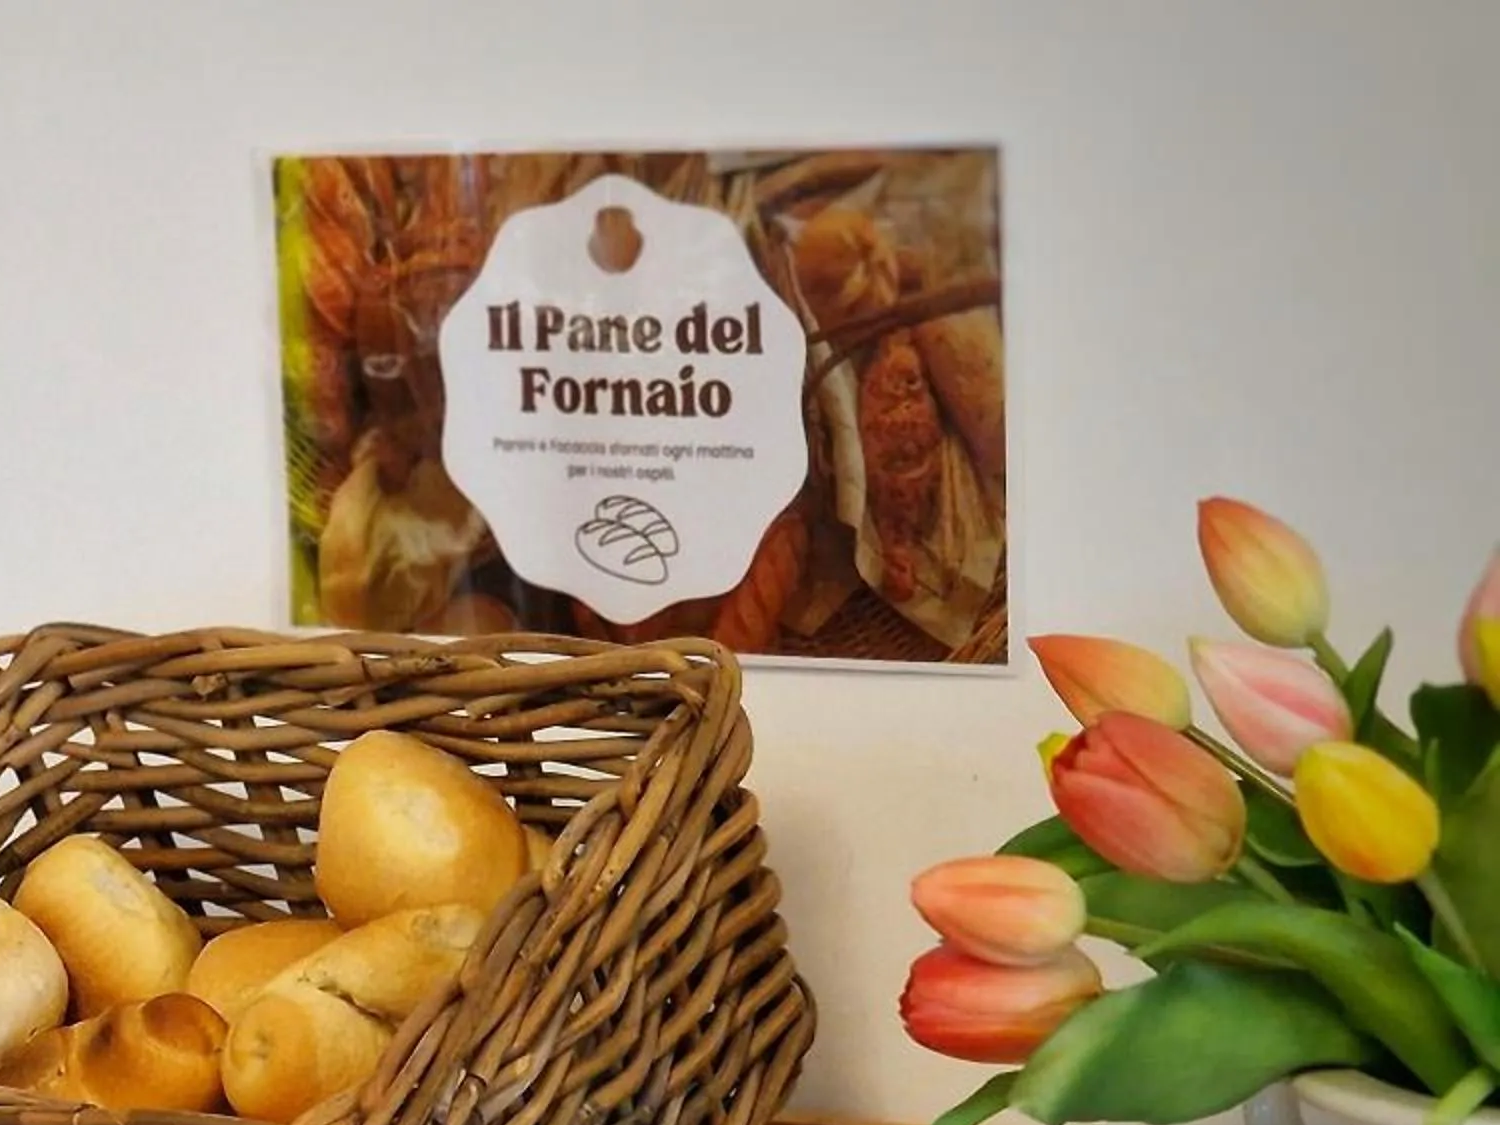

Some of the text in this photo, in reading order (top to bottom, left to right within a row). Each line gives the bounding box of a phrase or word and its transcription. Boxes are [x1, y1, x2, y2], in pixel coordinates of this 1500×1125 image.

[487, 301, 763, 354] Il Pane del
[520, 365, 733, 418] Fornaio
[662, 444, 694, 462] ogni
[696, 445, 754, 459] mattina
[567, 464, 587, 479] per
